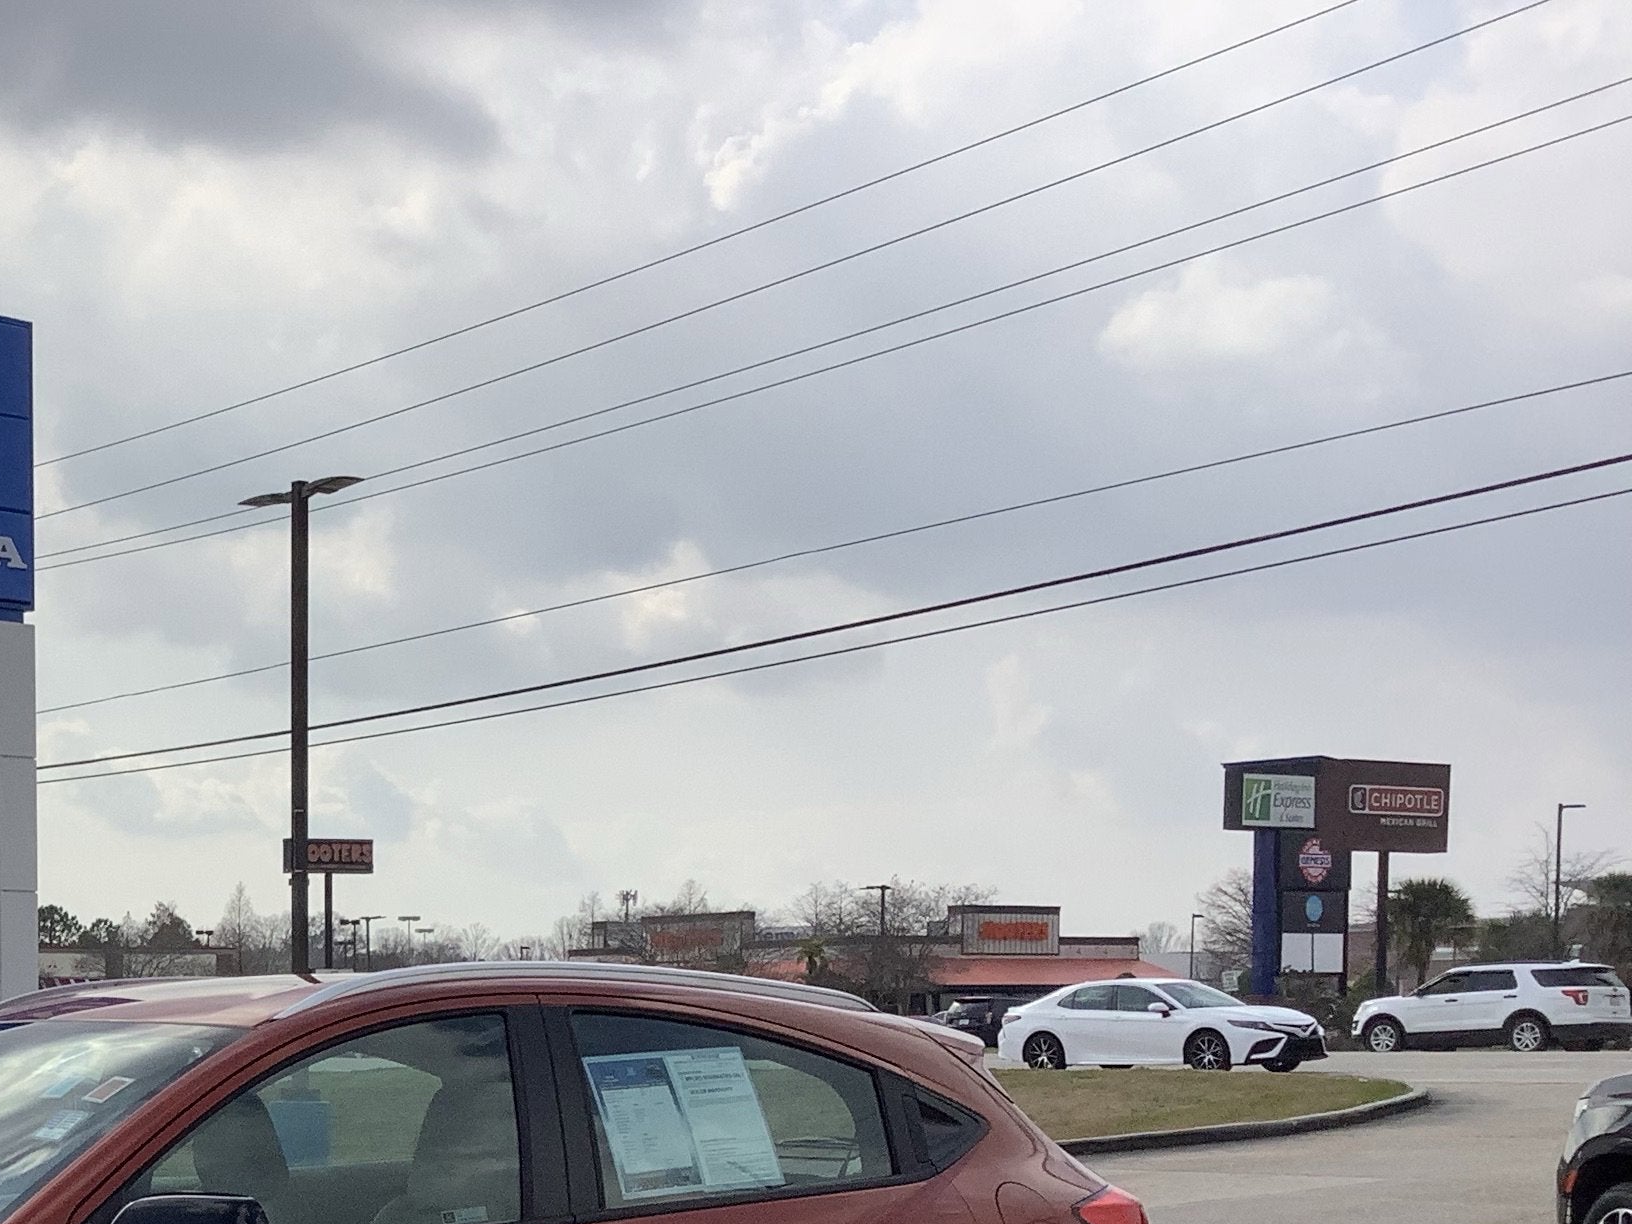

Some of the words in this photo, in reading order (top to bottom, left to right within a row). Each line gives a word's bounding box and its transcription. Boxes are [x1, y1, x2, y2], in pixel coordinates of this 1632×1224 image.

[1273, 792, 1312, 809] Express
[1371, 793, 1439, 809] CHIPOTLE
[1380, 818, 1414, 826] MEXICAN
[1416, 819, 1437, 828] GRILL
[307, 843, 372, 863] OOTERS
